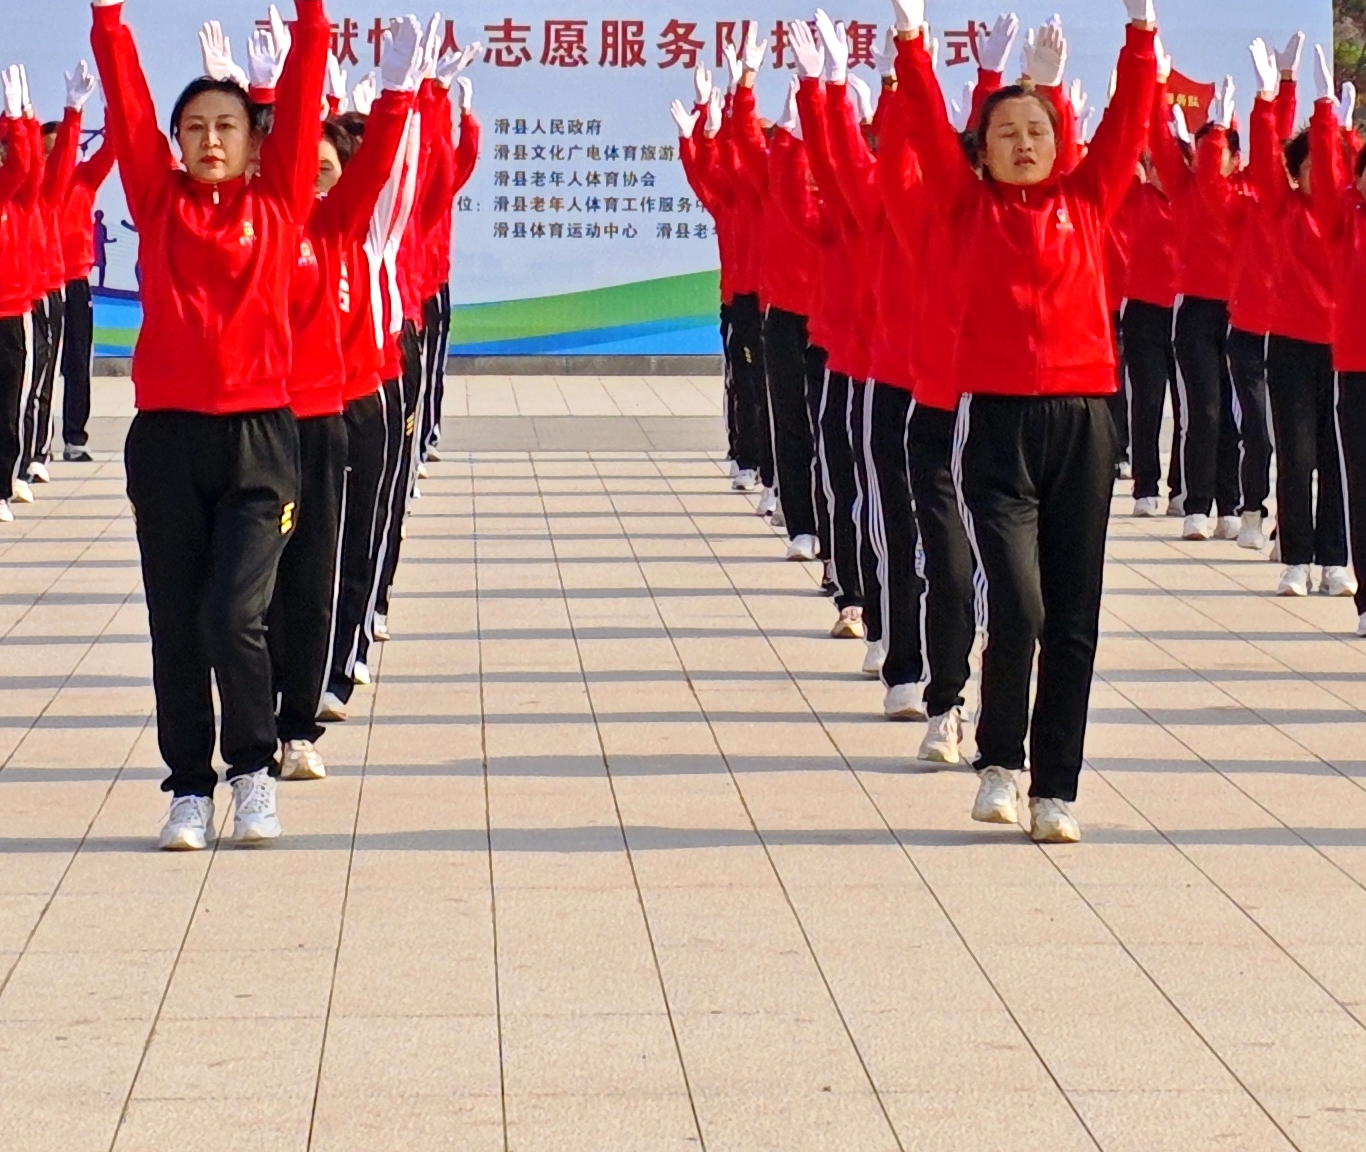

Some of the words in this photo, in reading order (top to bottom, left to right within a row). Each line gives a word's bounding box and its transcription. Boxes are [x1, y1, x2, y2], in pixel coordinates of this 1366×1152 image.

[494, 118, 601, 136] 滑县人民政府
[494, 144, 681, 162] 滑县文化广电体育旅游
[494, 170, 656, 188] 滑县老年人体育协会
[493, 222, 638, 239] 滑县体育运动中心
[656, 222, 717, 239] 滑县老
